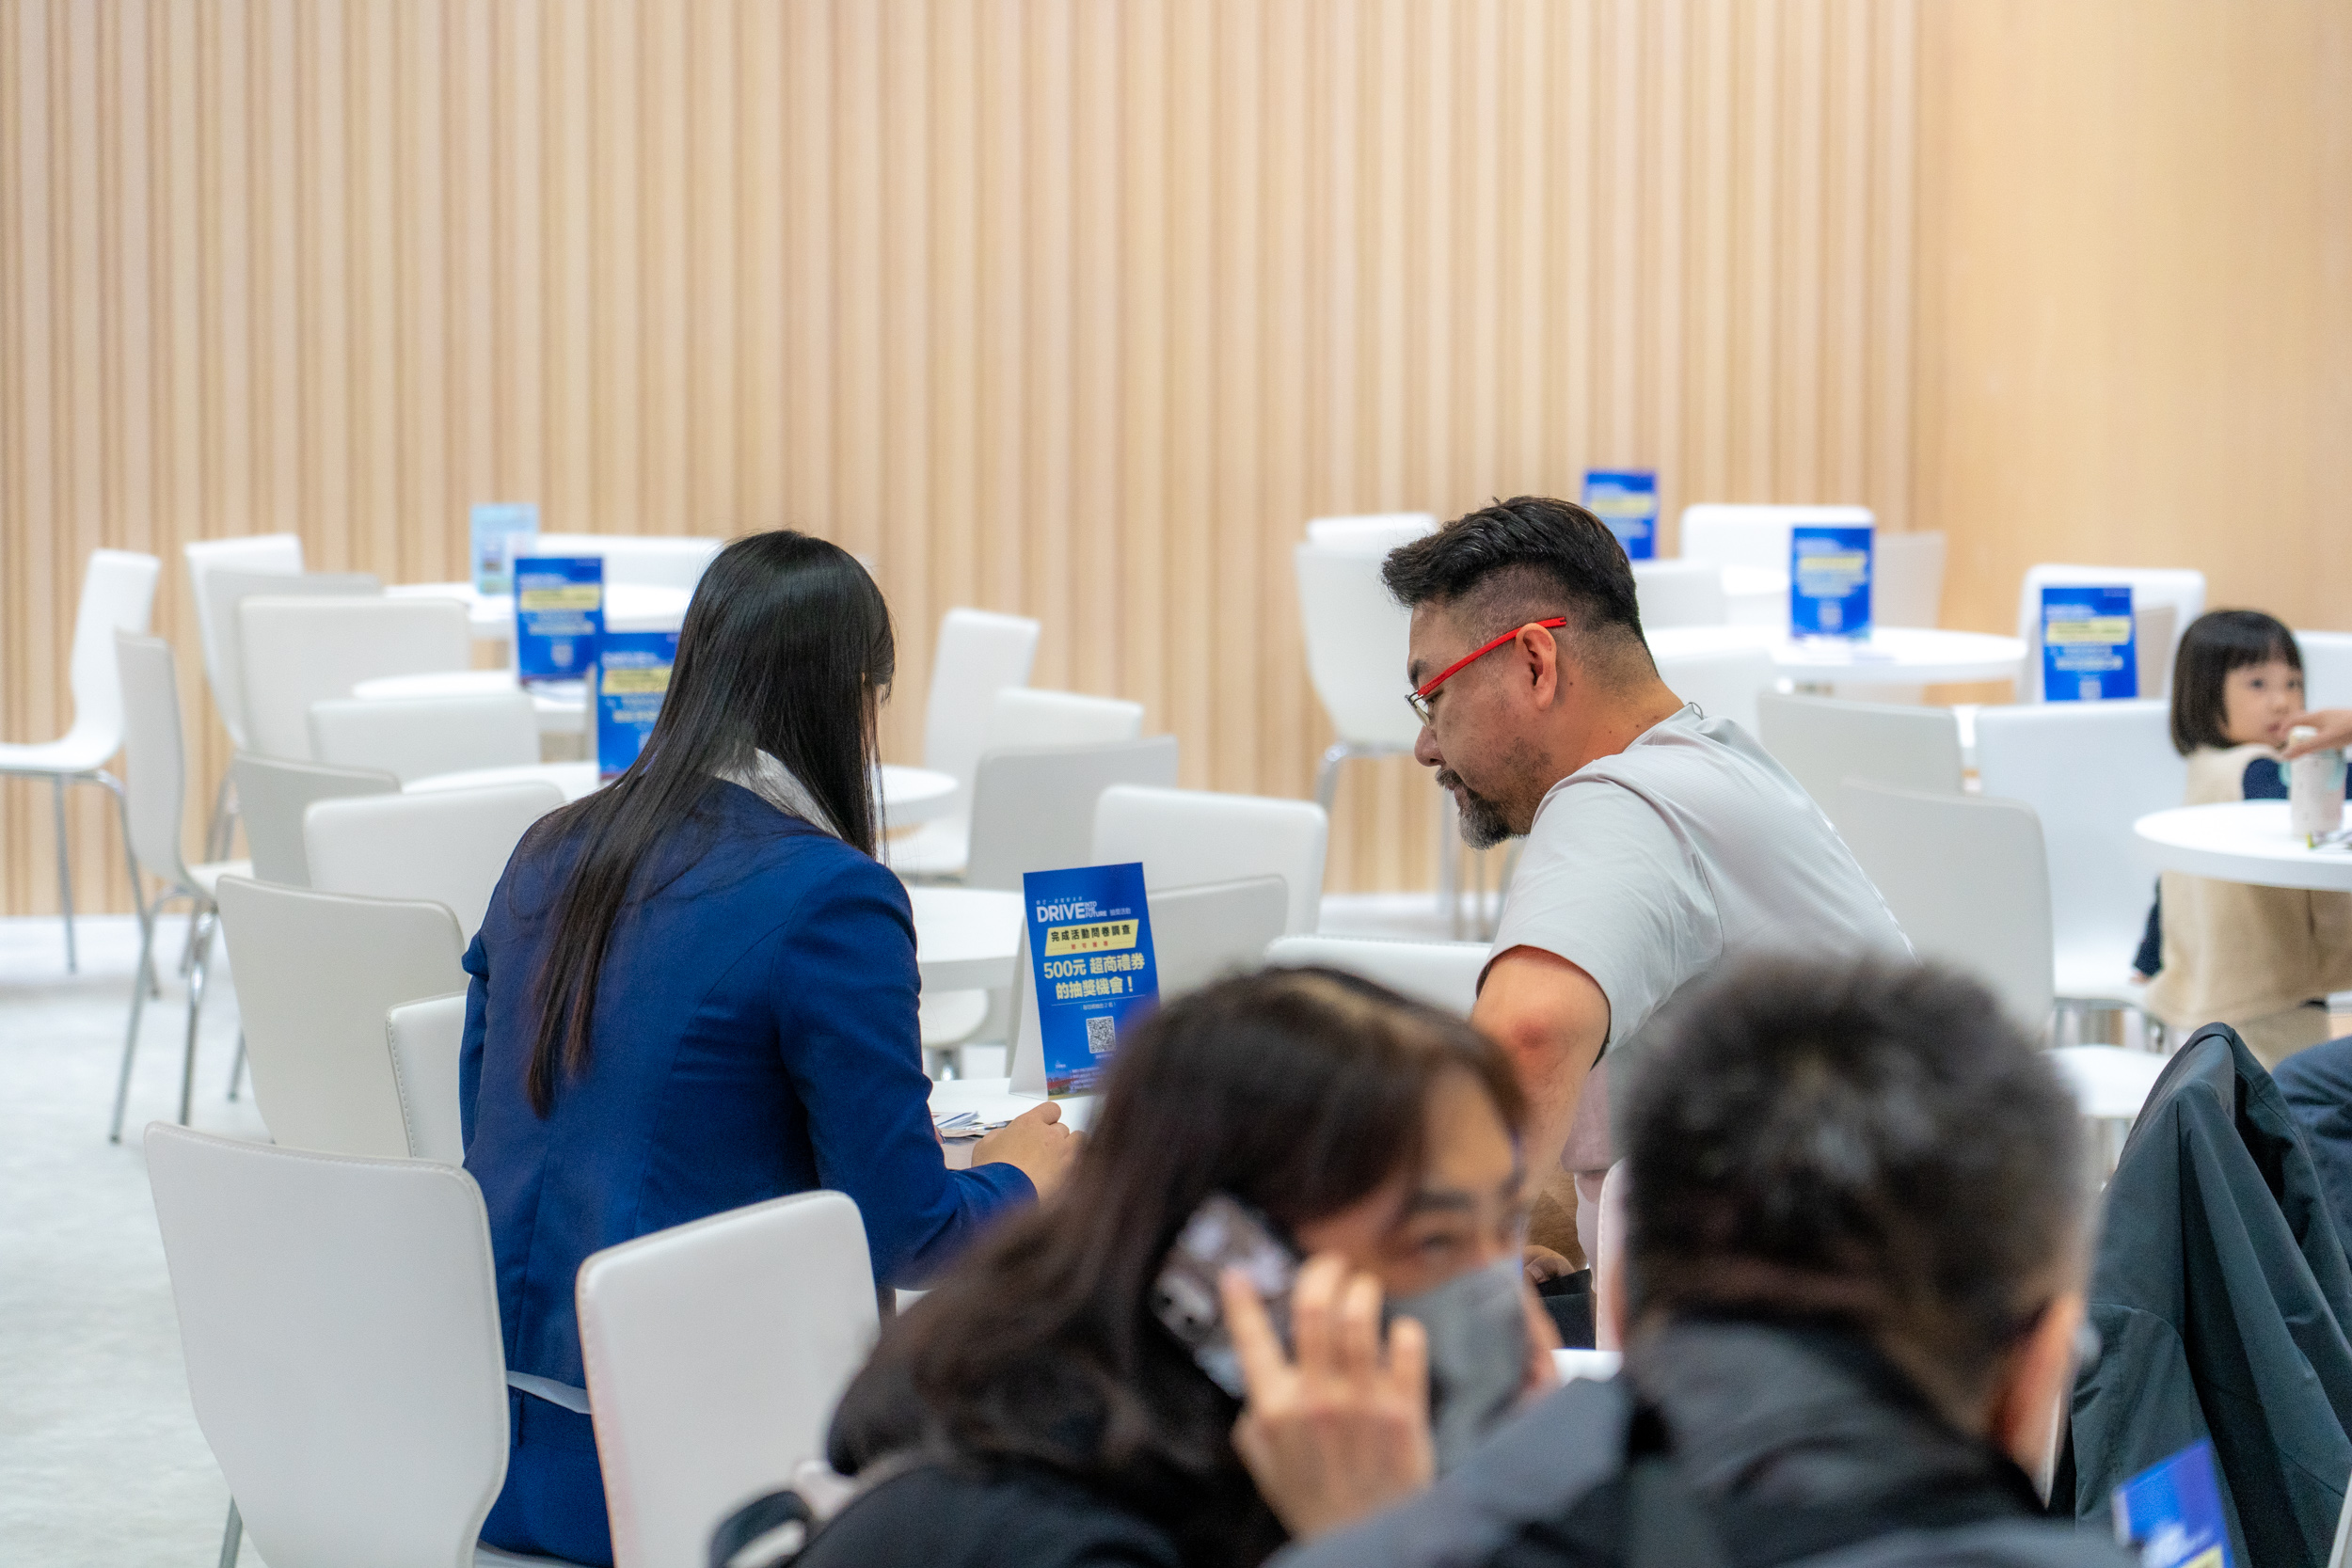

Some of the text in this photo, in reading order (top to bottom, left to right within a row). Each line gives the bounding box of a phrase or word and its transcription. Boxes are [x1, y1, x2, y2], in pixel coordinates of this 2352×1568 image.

[1037, 902, 1086, 923] DRIVE
[1051, 925, 1131, 942] 完成活動問卷調查
[1043, 953, 1145, 979] 500元 超商禮券
